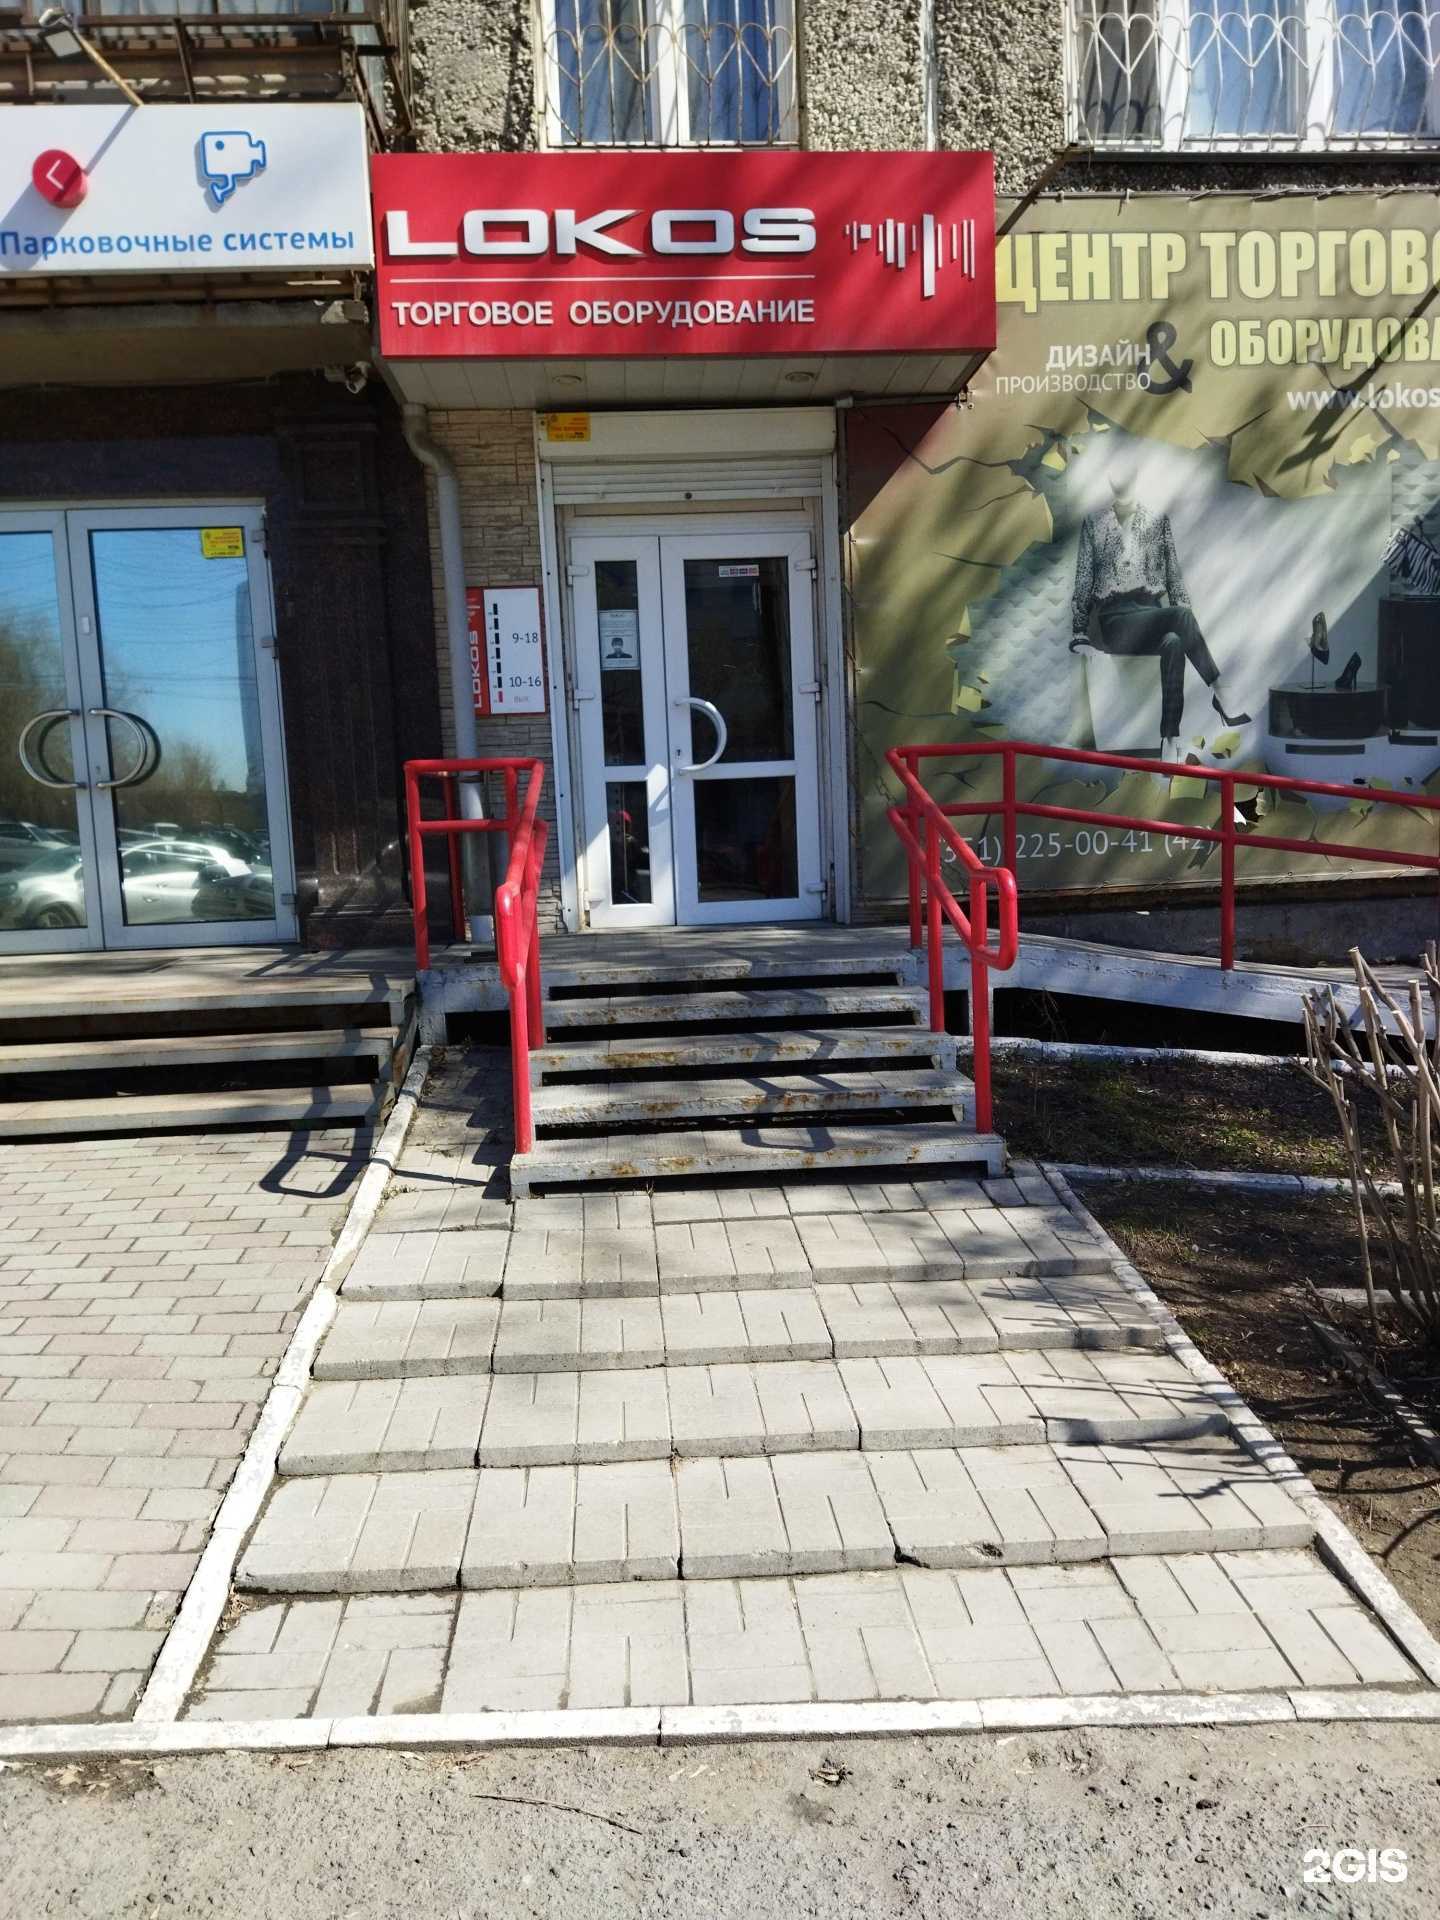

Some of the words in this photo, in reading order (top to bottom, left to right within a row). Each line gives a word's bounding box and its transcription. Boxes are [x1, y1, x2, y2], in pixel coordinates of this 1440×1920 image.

[0, 230, 213, 261] Парковочные
[223, 230, 354, 251] системы
[386, 207, 816, 257] LOKOS
[995, 232, 1186, 313] ЦЕНТР
[1200, 228, 1440, 299] ТОРГОВ
[392, 300, 553, 325] ТОРГОВОЕ
[569, 298, 815, 327] ОБОРУДОВАНИЕ
[1046, 339, 1150, 371] ДИЗАЙН
[1137, 321, 1193, 395] &
[996, 371, 1151, 394] ПРОИЗВОДСТВО
[512, 632, 539, 644] 9-18
[509, 676, 542, 688] 10-16
[1016, 830, 1153, 858] 225-00-41
